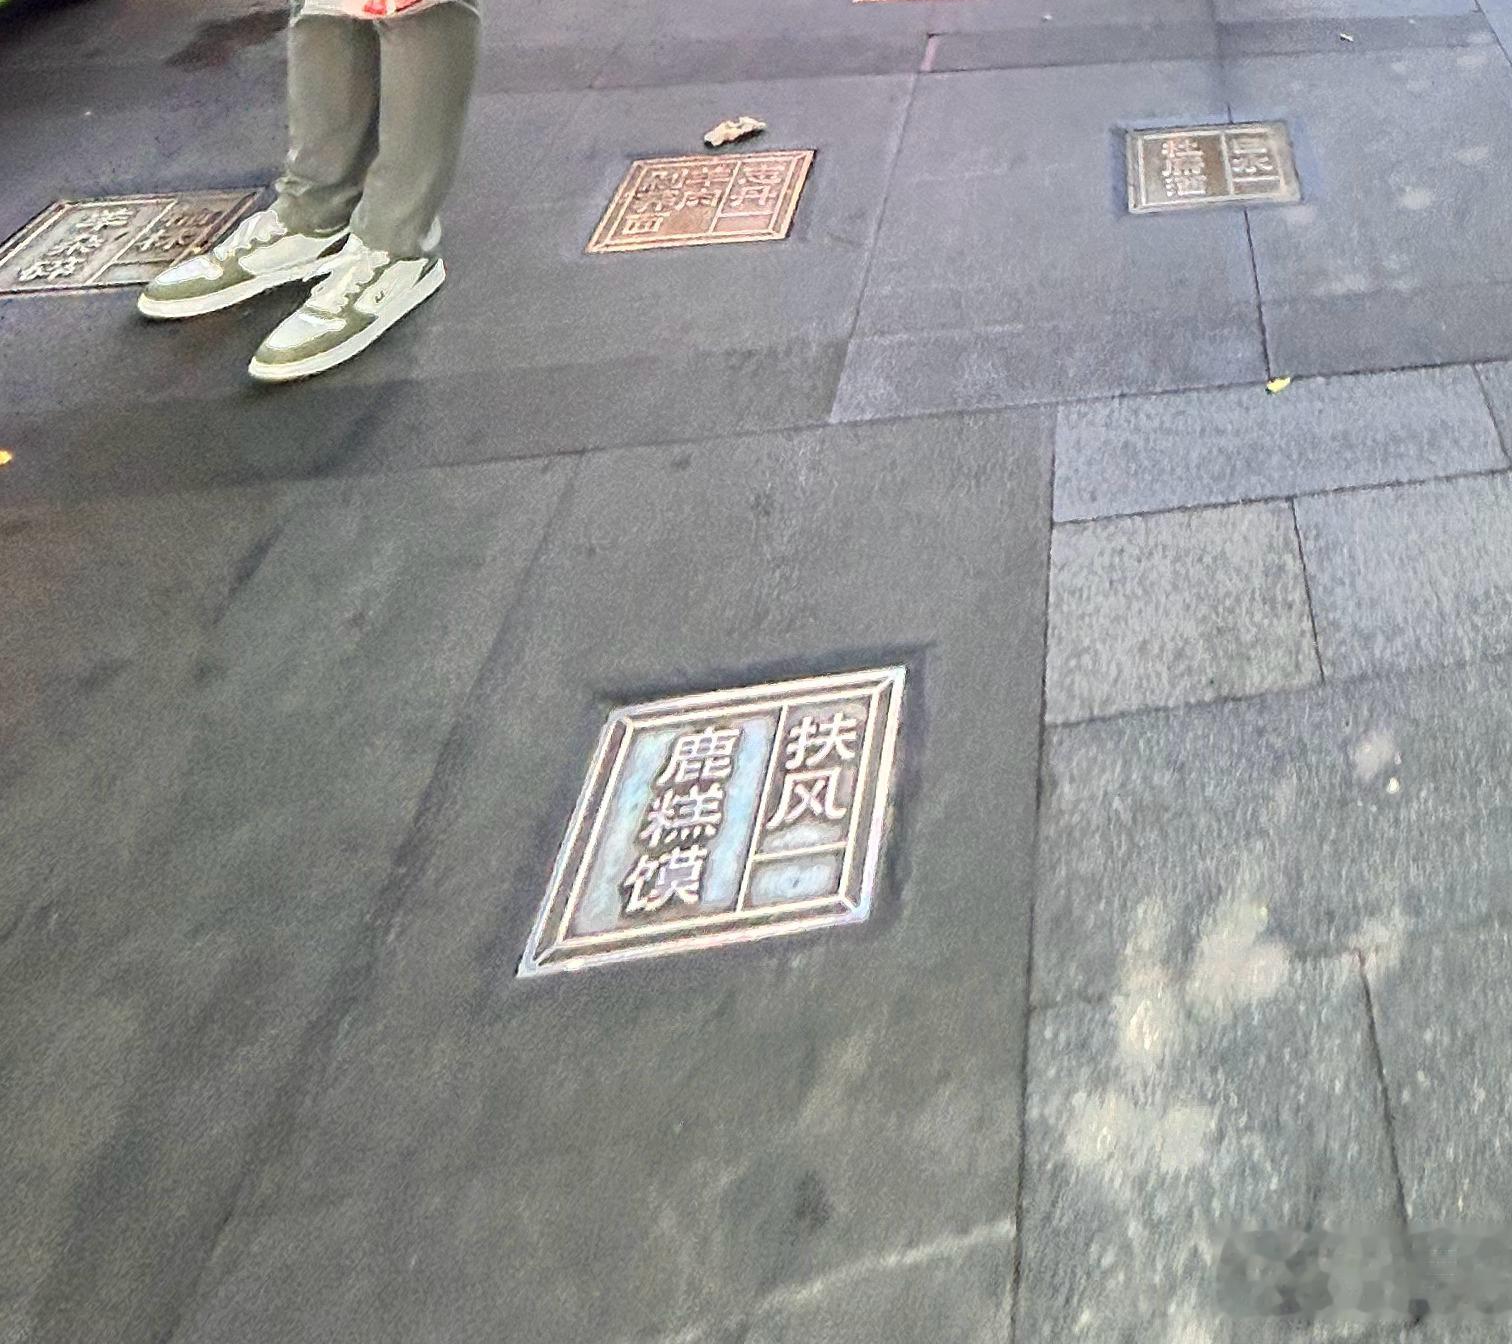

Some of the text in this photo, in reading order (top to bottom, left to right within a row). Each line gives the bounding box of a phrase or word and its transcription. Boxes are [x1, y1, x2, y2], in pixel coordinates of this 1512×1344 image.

[621, 725, 743, 914] 鹿糕馍
[766, 711, 859, 829] 扶风
